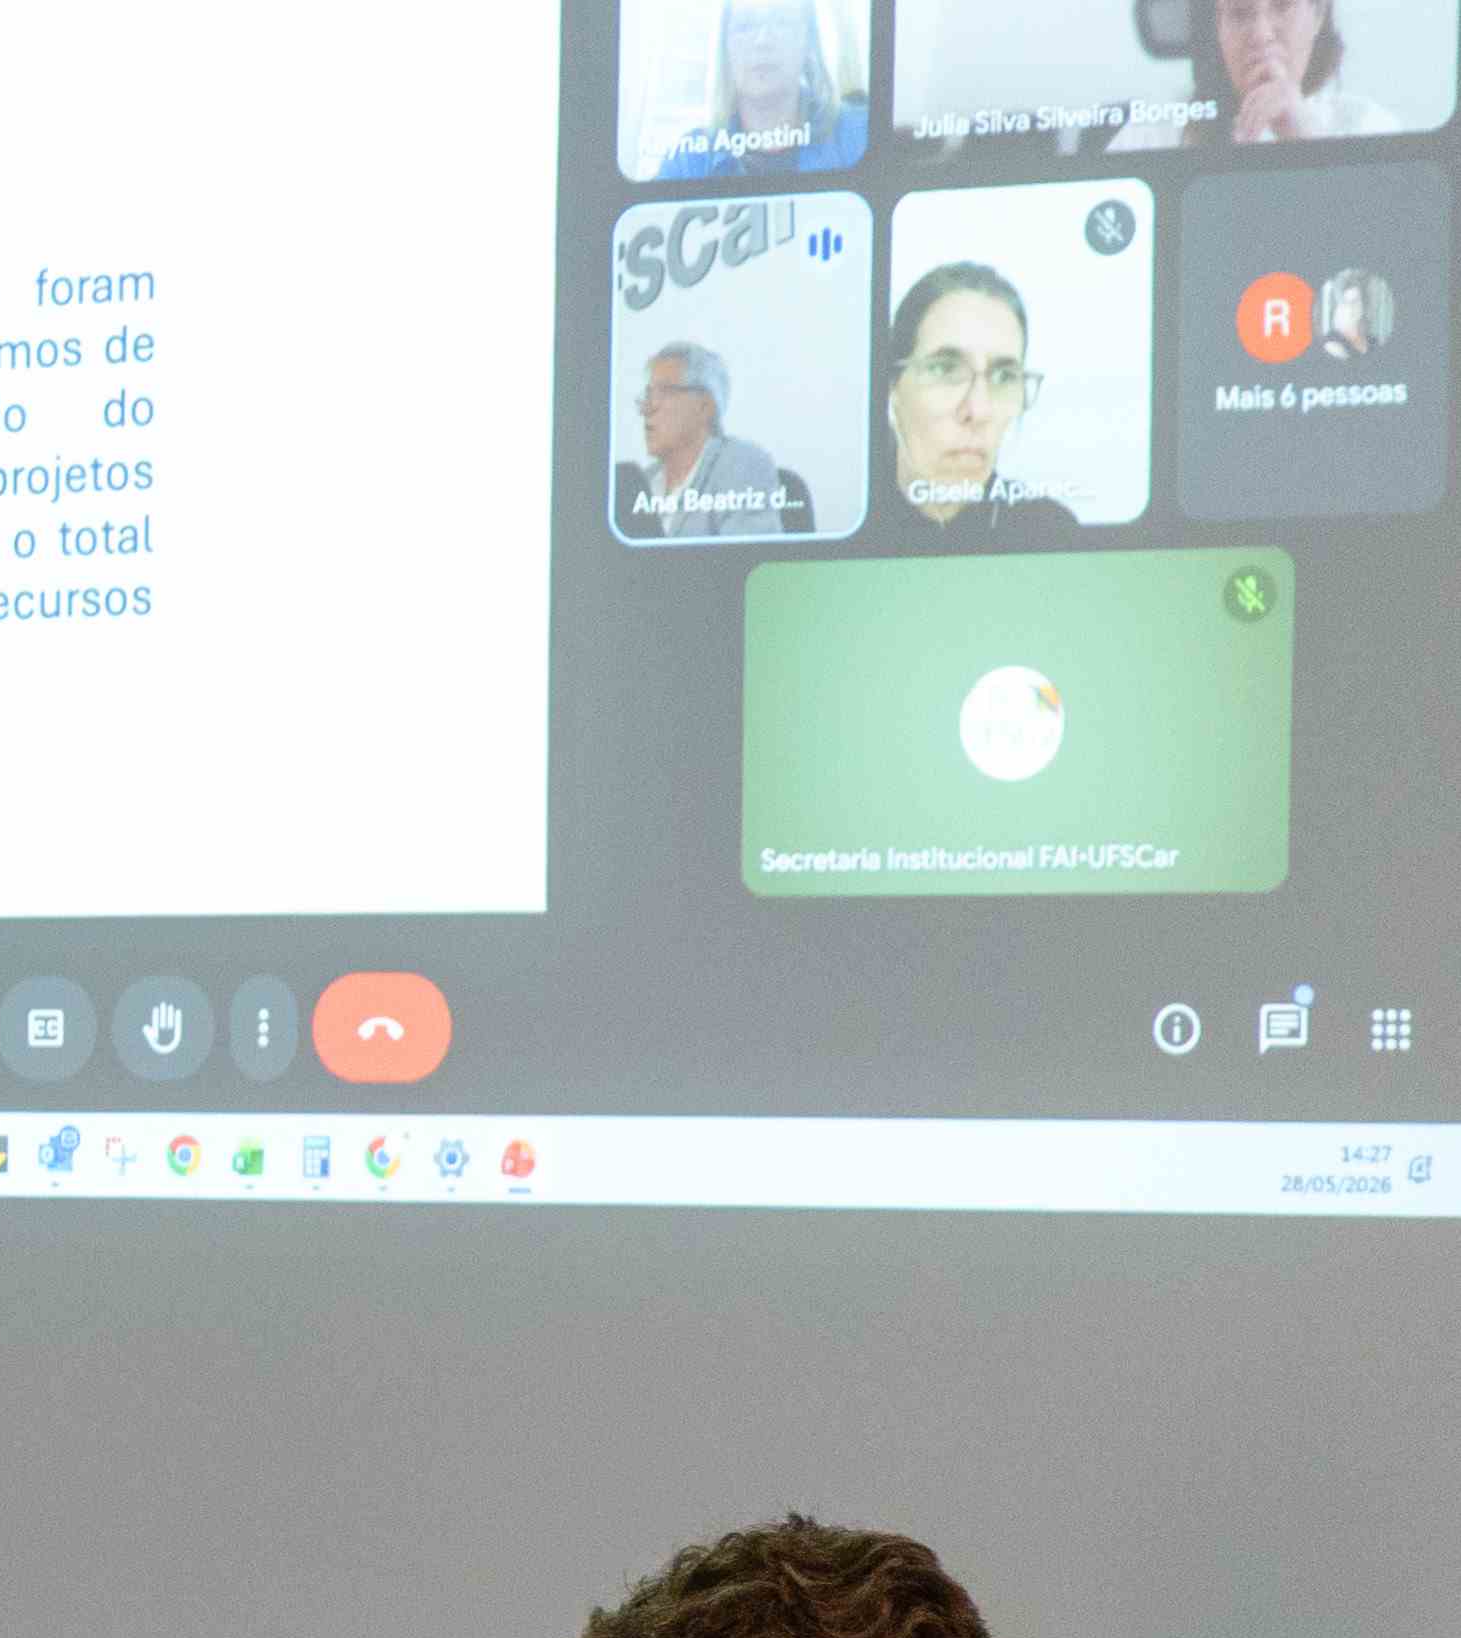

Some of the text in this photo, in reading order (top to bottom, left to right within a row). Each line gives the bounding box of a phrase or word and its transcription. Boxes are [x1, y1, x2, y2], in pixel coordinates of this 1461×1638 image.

[975, 110, 1030, 135] Silva
[1035, 104, 1123, 131] Silveira
[1128, 99, 1217, 125] Borges
[714, 122, 812, 157] Agostini
[35, 267, 155, 306] foram
[104, 326, 155, 365] de
[103, 391, 155, 429] do
[1215, 382, 1407, 414] Mais 6 pessoas
[633, 491, 678, 514] Ana
[683, 486, 766, 513] Beatriz
[908, 479, 984, 503] Gisele
[12, 529, 37, 559] o
[59, 514, 153, 557] total
[761, 847, 881, 873] Secretaria
[887, 846, 1034, 871] Institucional
[1342, 1144, 1393, 1164] 14:27
[1280, 1175, 1393, 1195] 28/05/2026
